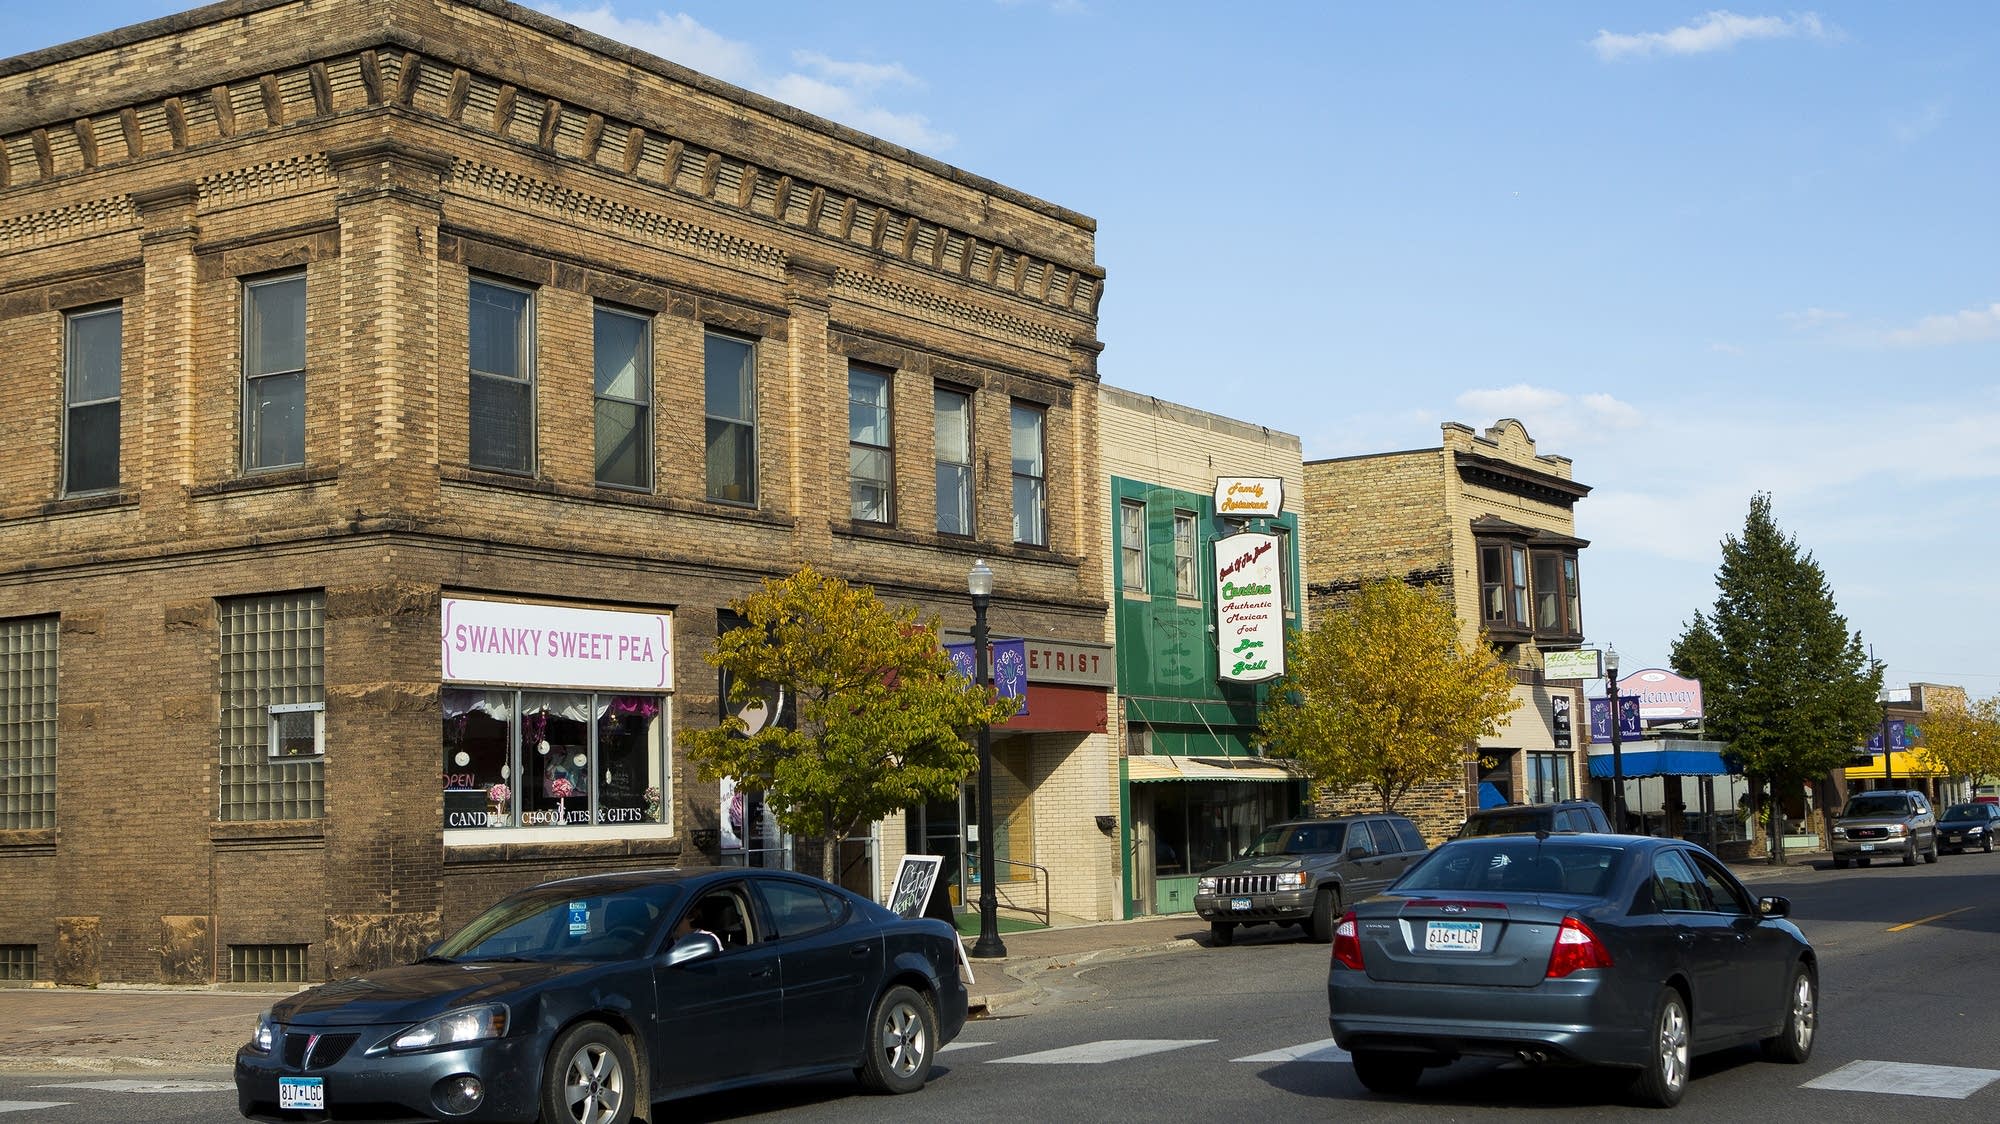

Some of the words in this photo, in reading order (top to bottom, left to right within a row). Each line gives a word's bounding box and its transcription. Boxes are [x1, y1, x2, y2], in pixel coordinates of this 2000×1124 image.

[1228, 482, 1264, 497] Family
[1222, 497, 1268, 511] Restaurant
[1222, 582, 1271, 600] Cantina
[1221, 601, 1272, 612] Authentic
[1226, 613, 1268, 624] Mexican
[1237, 624, 1258, 635] Food
[455, 624, 542, 657] SWANKY
[548, 630, 613, 660] SWEET
[618, 635, 654, 662] PEA
[1233, 639, 1264, 653] Bar
[1232, 660, 1268, 676] Grill
[1621, 686, 1696, 710] deaway
[443, 774, 475, 789] OPEN
[598, 809, 606, 822] &
[607, 808, 642, 822] GIFTS
[1429, 929, 1450, 943] 616
[1457, 930, 1478, 944] LCR
[282, 1085, 298, 1100] 817
[305, 1085, 322, 1101] LGC
